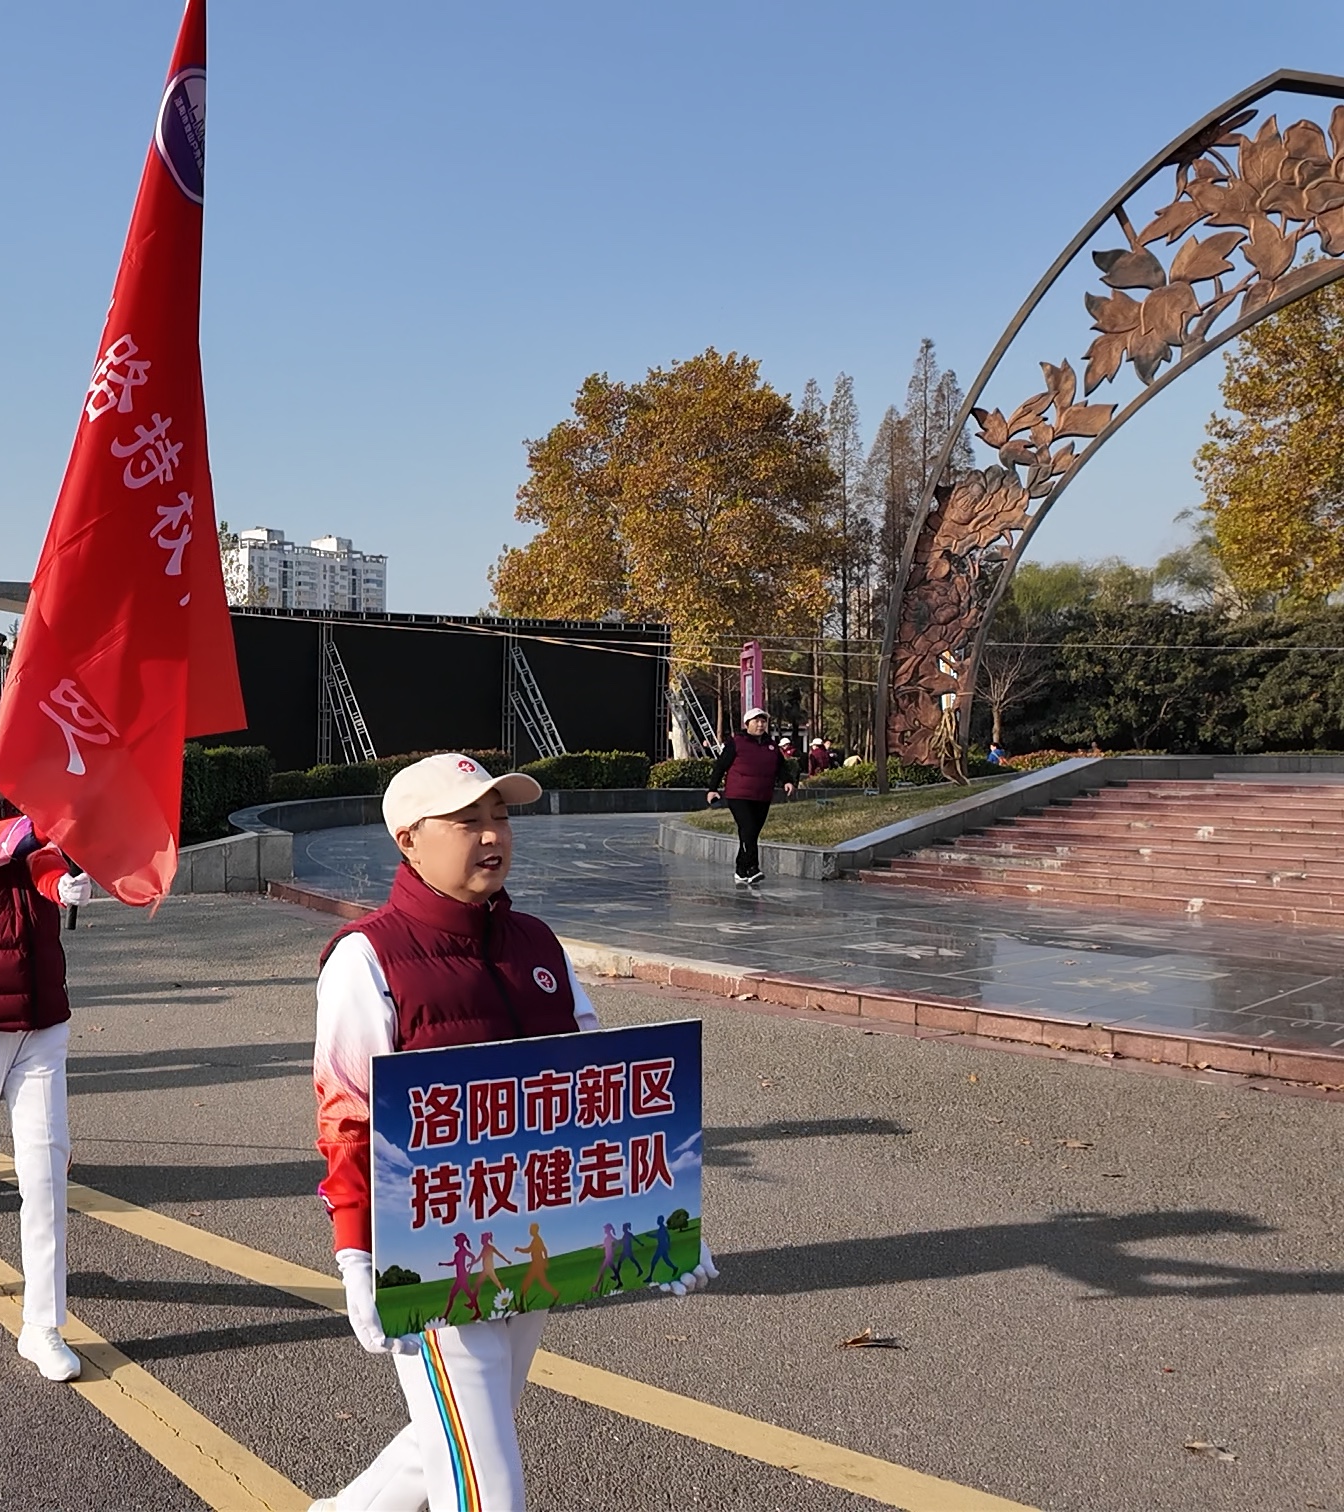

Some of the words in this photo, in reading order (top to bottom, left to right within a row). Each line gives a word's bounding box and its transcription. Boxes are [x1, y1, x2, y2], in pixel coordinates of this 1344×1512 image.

[86, 334, 194, 606] 路持杖
[409, 1057, 674, 1151] 洛阳市新区
[409, 1133, 674, 1231] 持杖健走队
